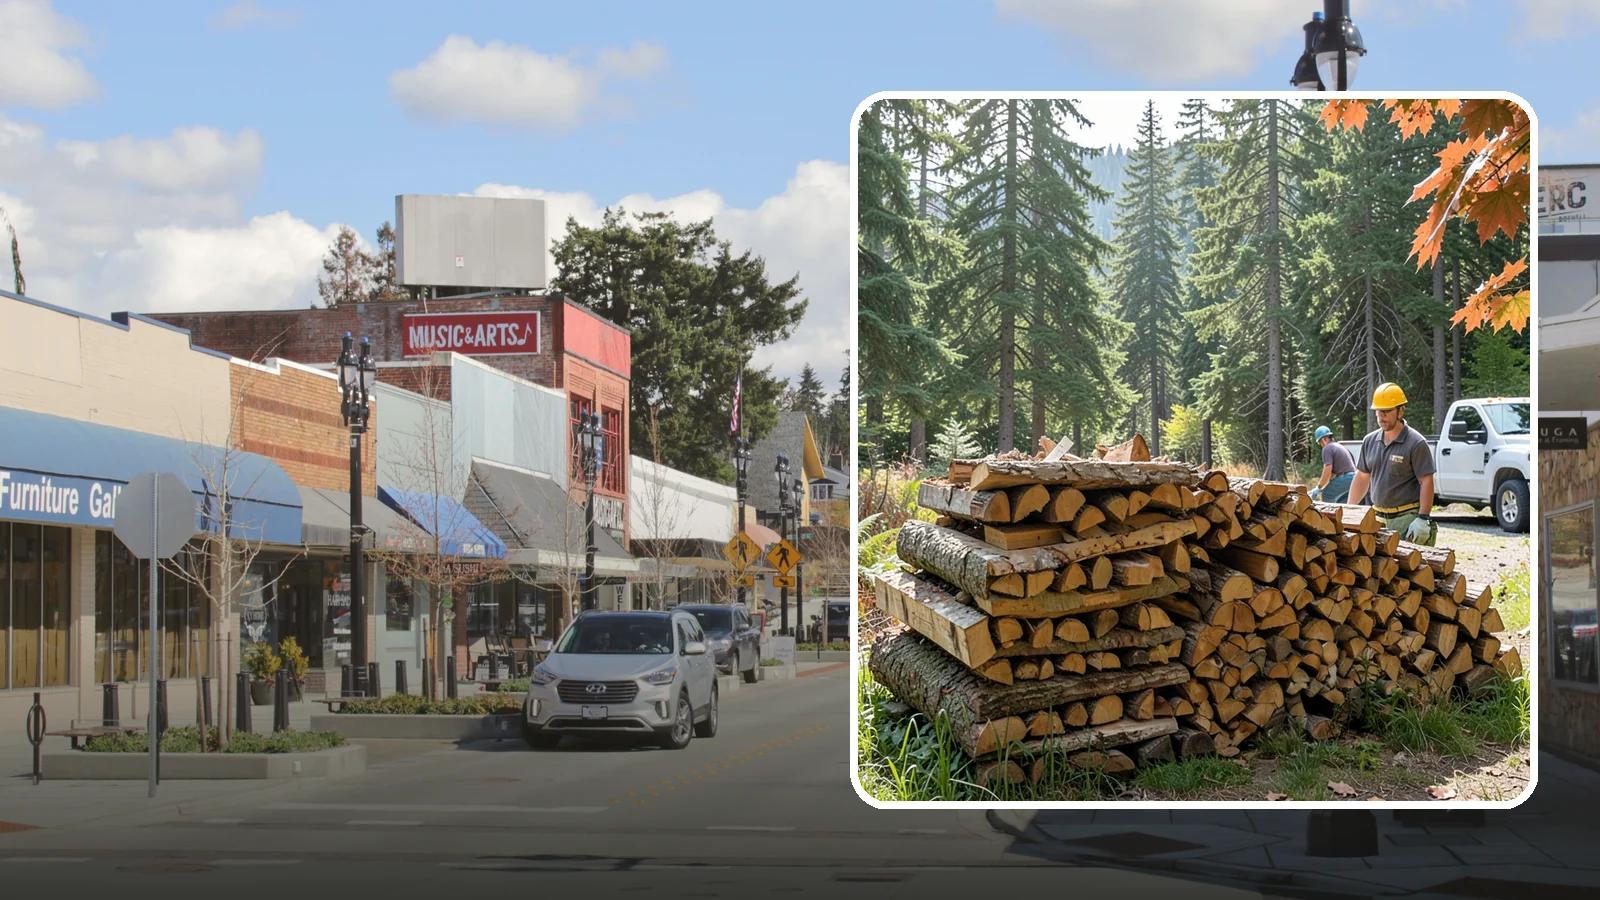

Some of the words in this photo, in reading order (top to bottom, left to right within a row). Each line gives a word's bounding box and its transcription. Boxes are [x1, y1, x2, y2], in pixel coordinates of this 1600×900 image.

[409, 323, 519, 348] MUSIC&ARTS
[1540, 427, 1577, 437] UGA
[0, 471, 79, 515] Furniture
[89, 482, 121, 519] Gal
[453, 563, 479, 574] SUSHI
